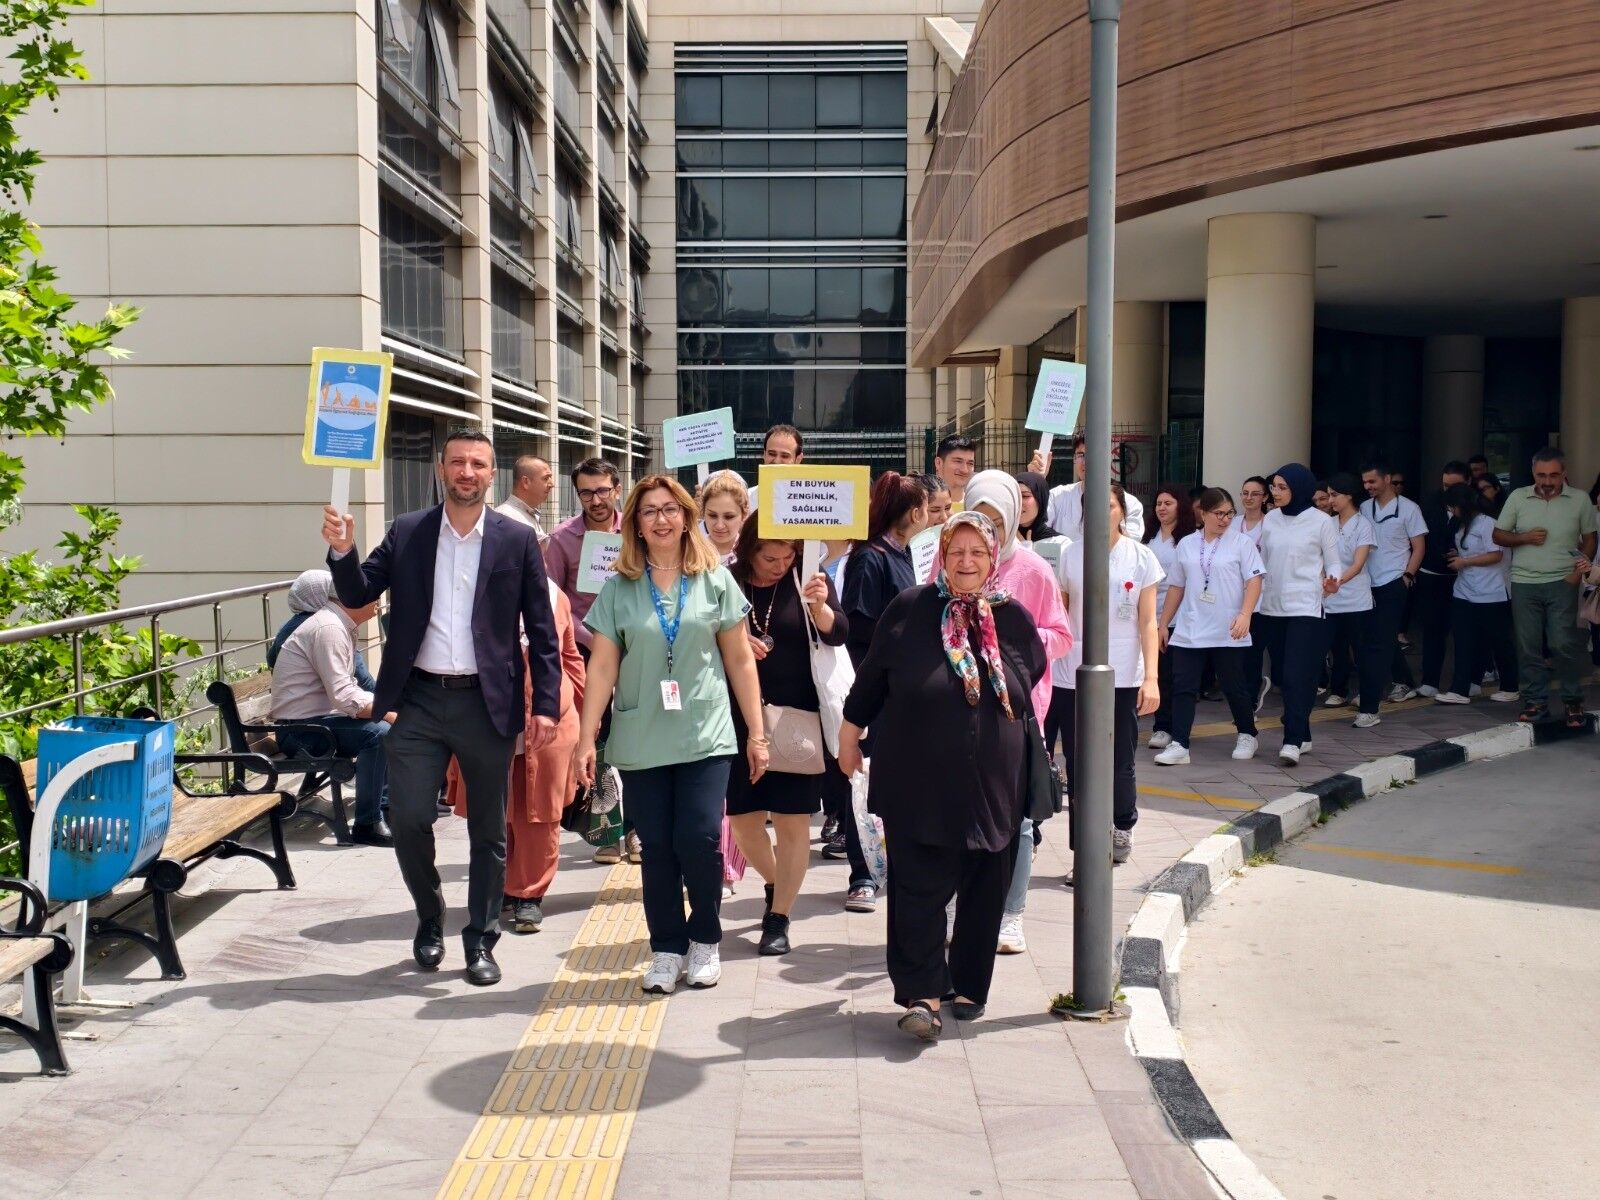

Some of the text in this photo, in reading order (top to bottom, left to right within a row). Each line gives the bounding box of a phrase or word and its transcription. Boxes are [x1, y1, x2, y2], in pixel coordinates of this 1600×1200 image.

[804, 479, 836, 488] BÜYÜK
[787, 492, 838, 501] ZENGİNLİK,
[791, 504, 833, 513] SAĞLIKLI
